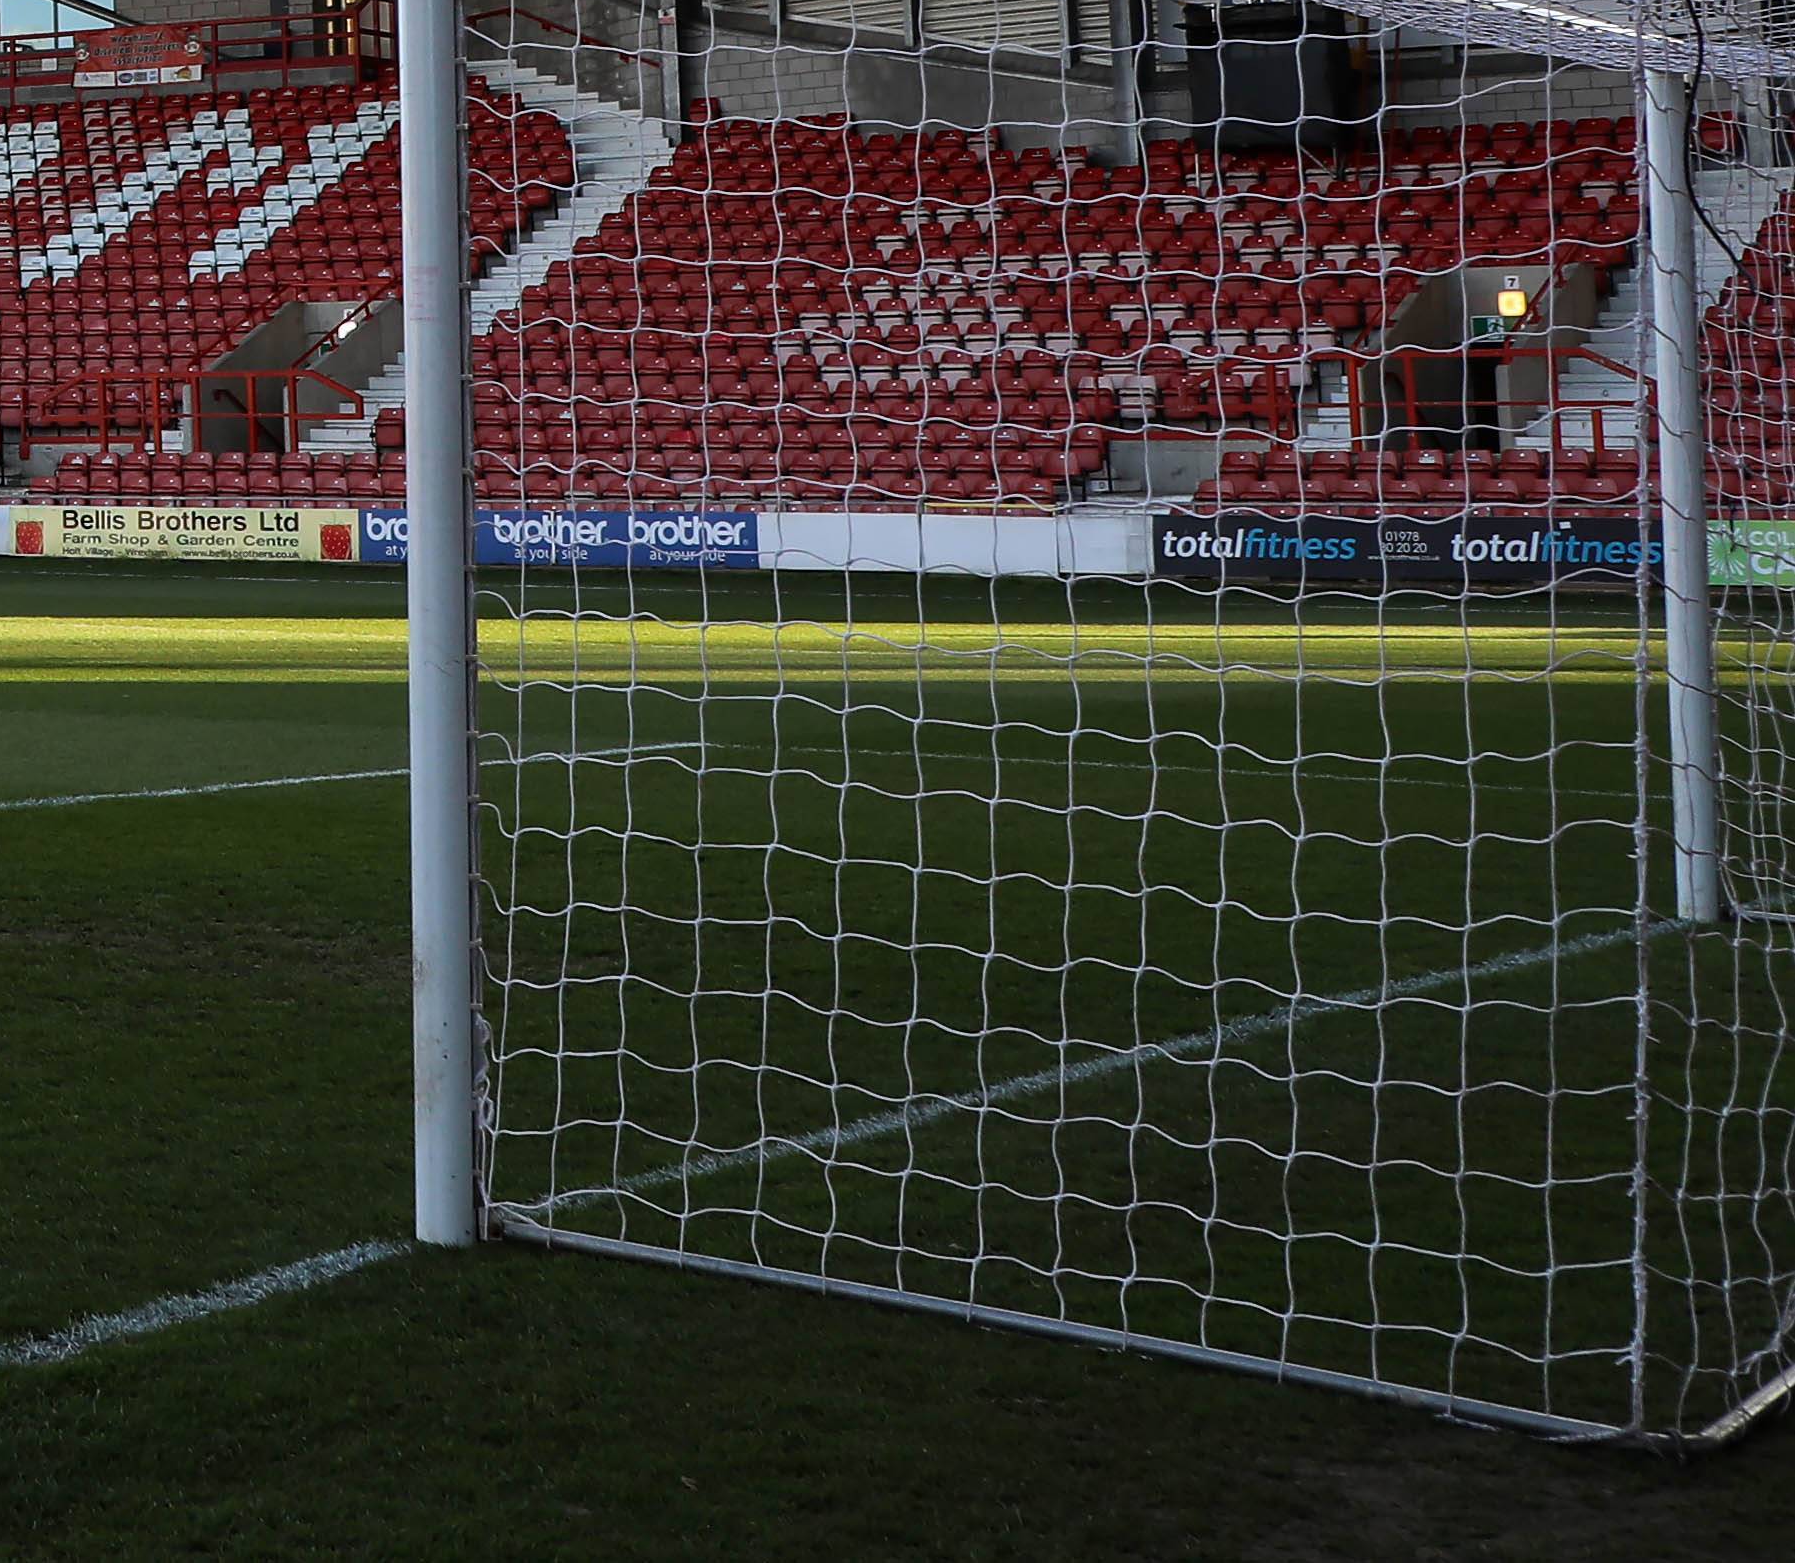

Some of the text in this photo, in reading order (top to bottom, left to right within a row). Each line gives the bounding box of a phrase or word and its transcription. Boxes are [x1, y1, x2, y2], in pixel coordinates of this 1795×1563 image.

[1507, 277, 1516, 288] 7
[63, 510, 299, 532] Bellis Brothers Ltd
[494, 514, 607, 547] brother
[628, 516, 746, 545] brother
[1385, 531, 1420, 542] 01978
[63, 533, 299, 548] Farm Shop & Garden Centre
[1163, 528, 1356, 559] totalfitness
[1396, 542, 1410, 553] 20
[1412, 542, 1427, 553] 20
[1451, 531, 1663, 564] totalfitness
[62, 547, 82, 556] Holt
[85, 547, 114, 557] Village
[125, 548, 169, 557] Wrexham
[385, 545, 397, 556] at
[561, 546, 588, 559] side
